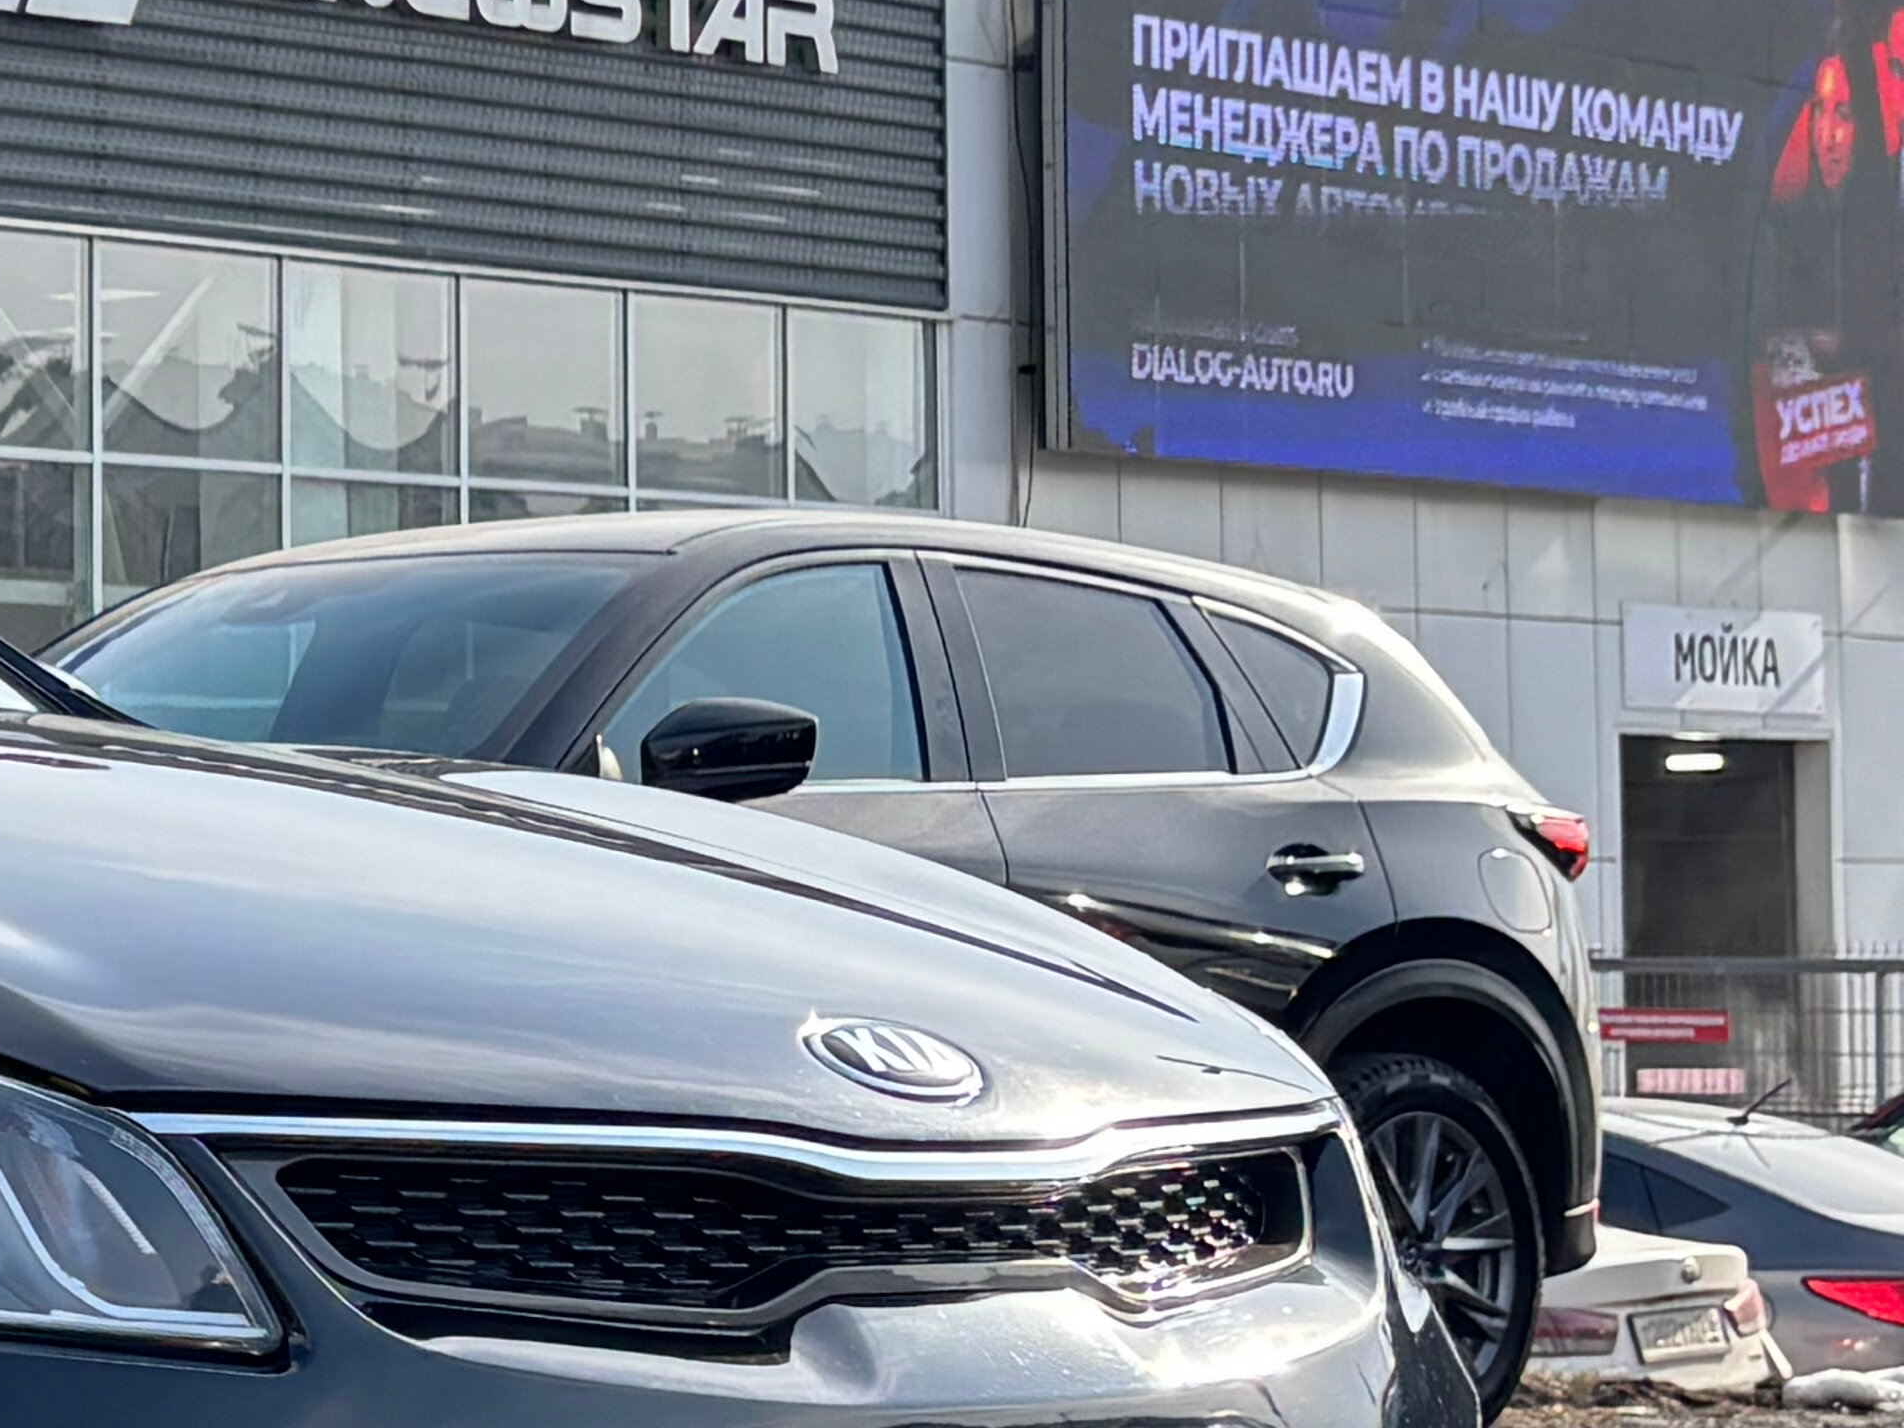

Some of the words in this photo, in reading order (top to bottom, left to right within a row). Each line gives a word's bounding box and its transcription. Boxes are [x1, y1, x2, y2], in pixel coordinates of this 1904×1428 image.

[1133, 14, 1411, 109] ПРИГЛАШАЕМ
[1420, 59, 1445, 114] В
[1453, 64, 1565, 132] НАШУ
[1572, 84, 1742, 165] КОМАНДУ
[1133, 83, 1385, 176] МЕНЕДЖЕРА
[1394, 125, 1449, 184] ПО
[1457, 135, 1669, 206] ПРОДАЖАМ
[1132, 343, 1354, 398] DIALOG-AUTO.RU
[1776, 379, 1865, 440] УСПЕХ
[1674, 623, 1780, 687] МОЙКА
